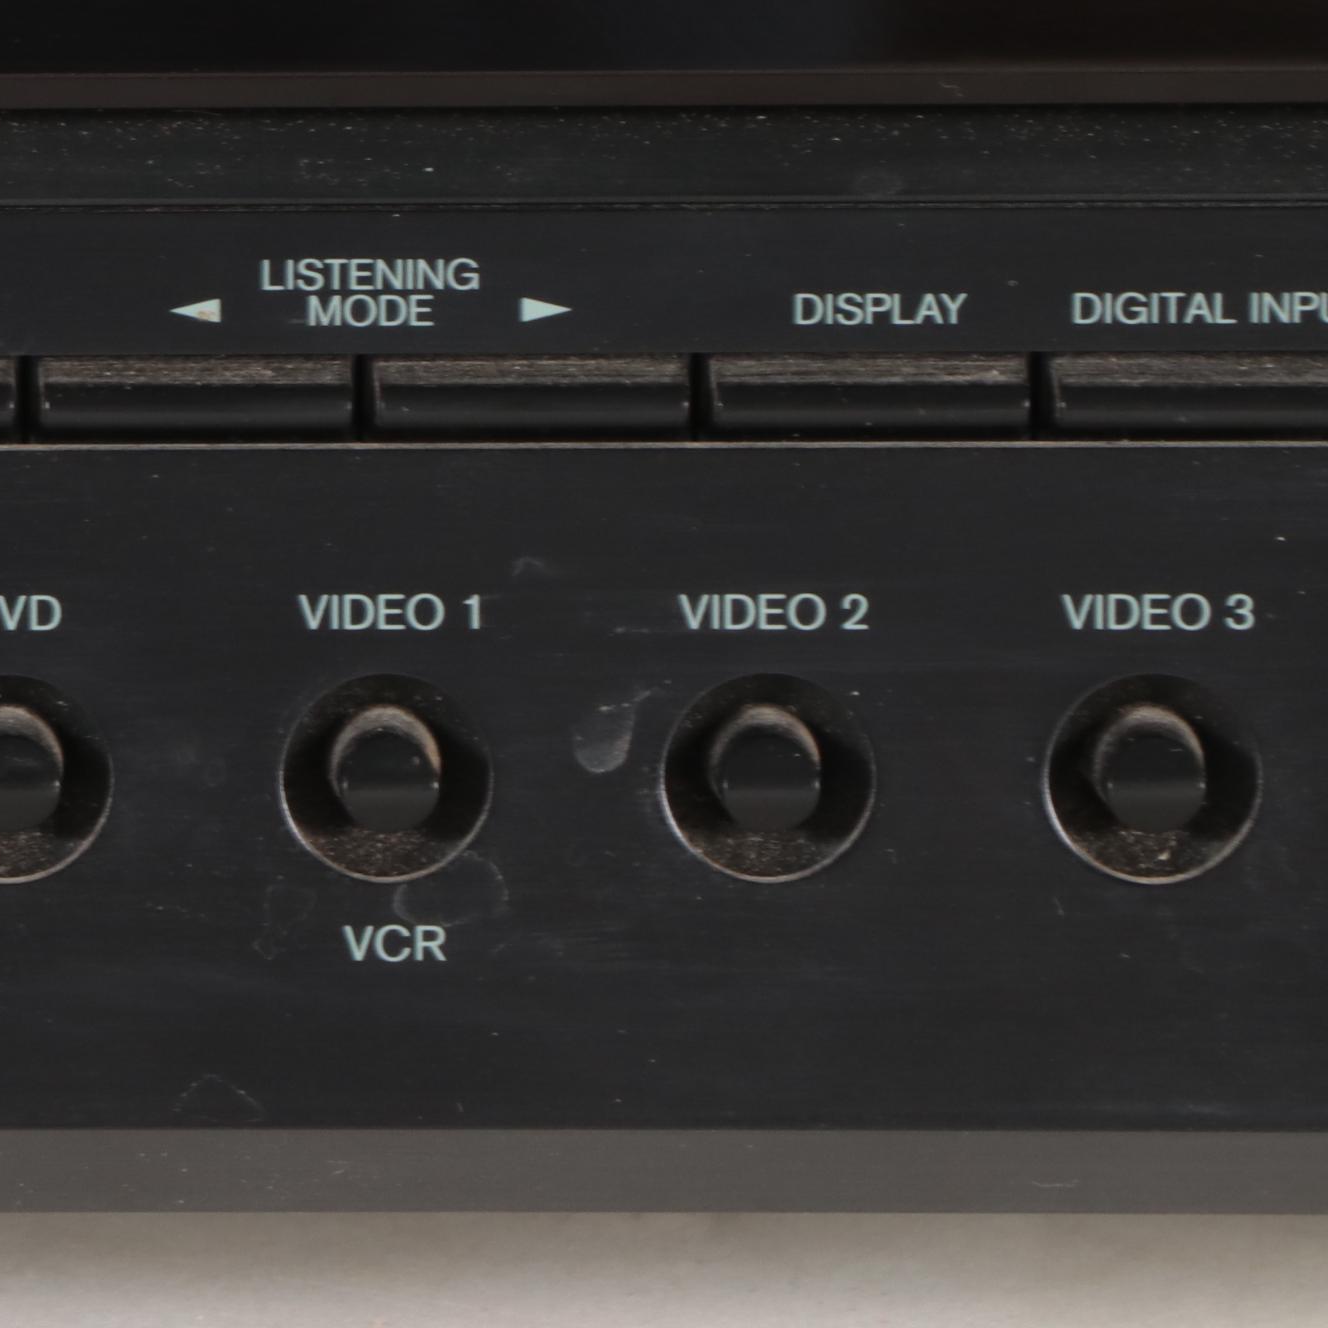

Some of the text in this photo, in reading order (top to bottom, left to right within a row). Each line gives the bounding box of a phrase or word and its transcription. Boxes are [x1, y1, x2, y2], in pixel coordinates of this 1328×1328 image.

[261, 257, 480, 291] LISTENING
[308, 294, 435, 327] MODE
[795, 292, 967, 326] DISPLAY
[1073, 291, 1238, 325] DIGITAL
[298, 593, 482, 631] VIDEO 1
[679, 593, 870, 632] VIDEO 2
[1062, 593, 1256, 632] VIDEO 3
[343, 924, 449, 963] VCR
